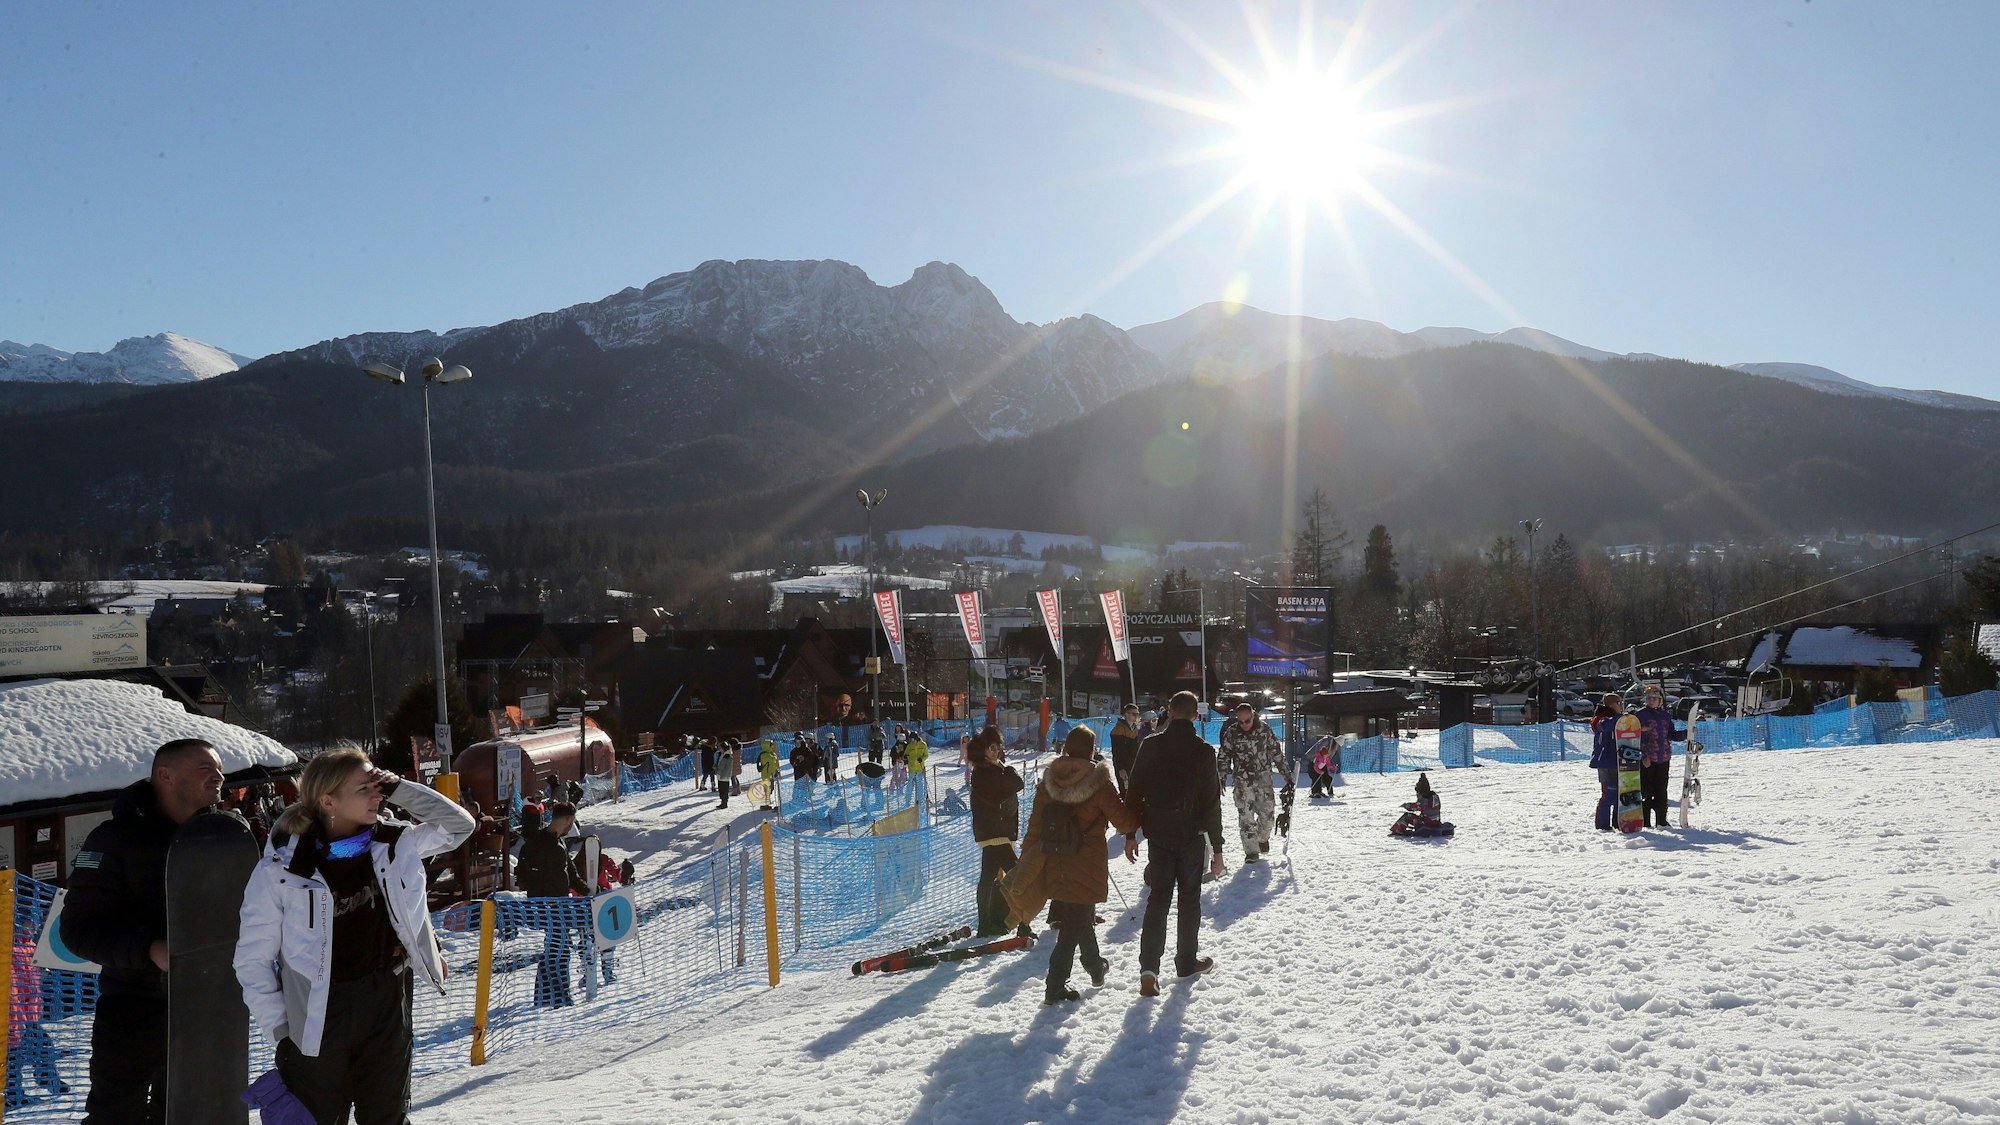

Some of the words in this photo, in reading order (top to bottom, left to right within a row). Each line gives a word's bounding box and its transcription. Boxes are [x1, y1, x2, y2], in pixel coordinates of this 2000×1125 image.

[1277, 597, 1302, 605] BASEN
[1303, 598, 1309, 606] &
[1310, 597, 1325, 606] SPA
[1129, 636, 1165, 645] EAD
[8, 645, 62, 653] KINDERGARTEN
[92, 656, 139, 664] SZYMOSZKOWA
[607, 905, 620, 931] 1
